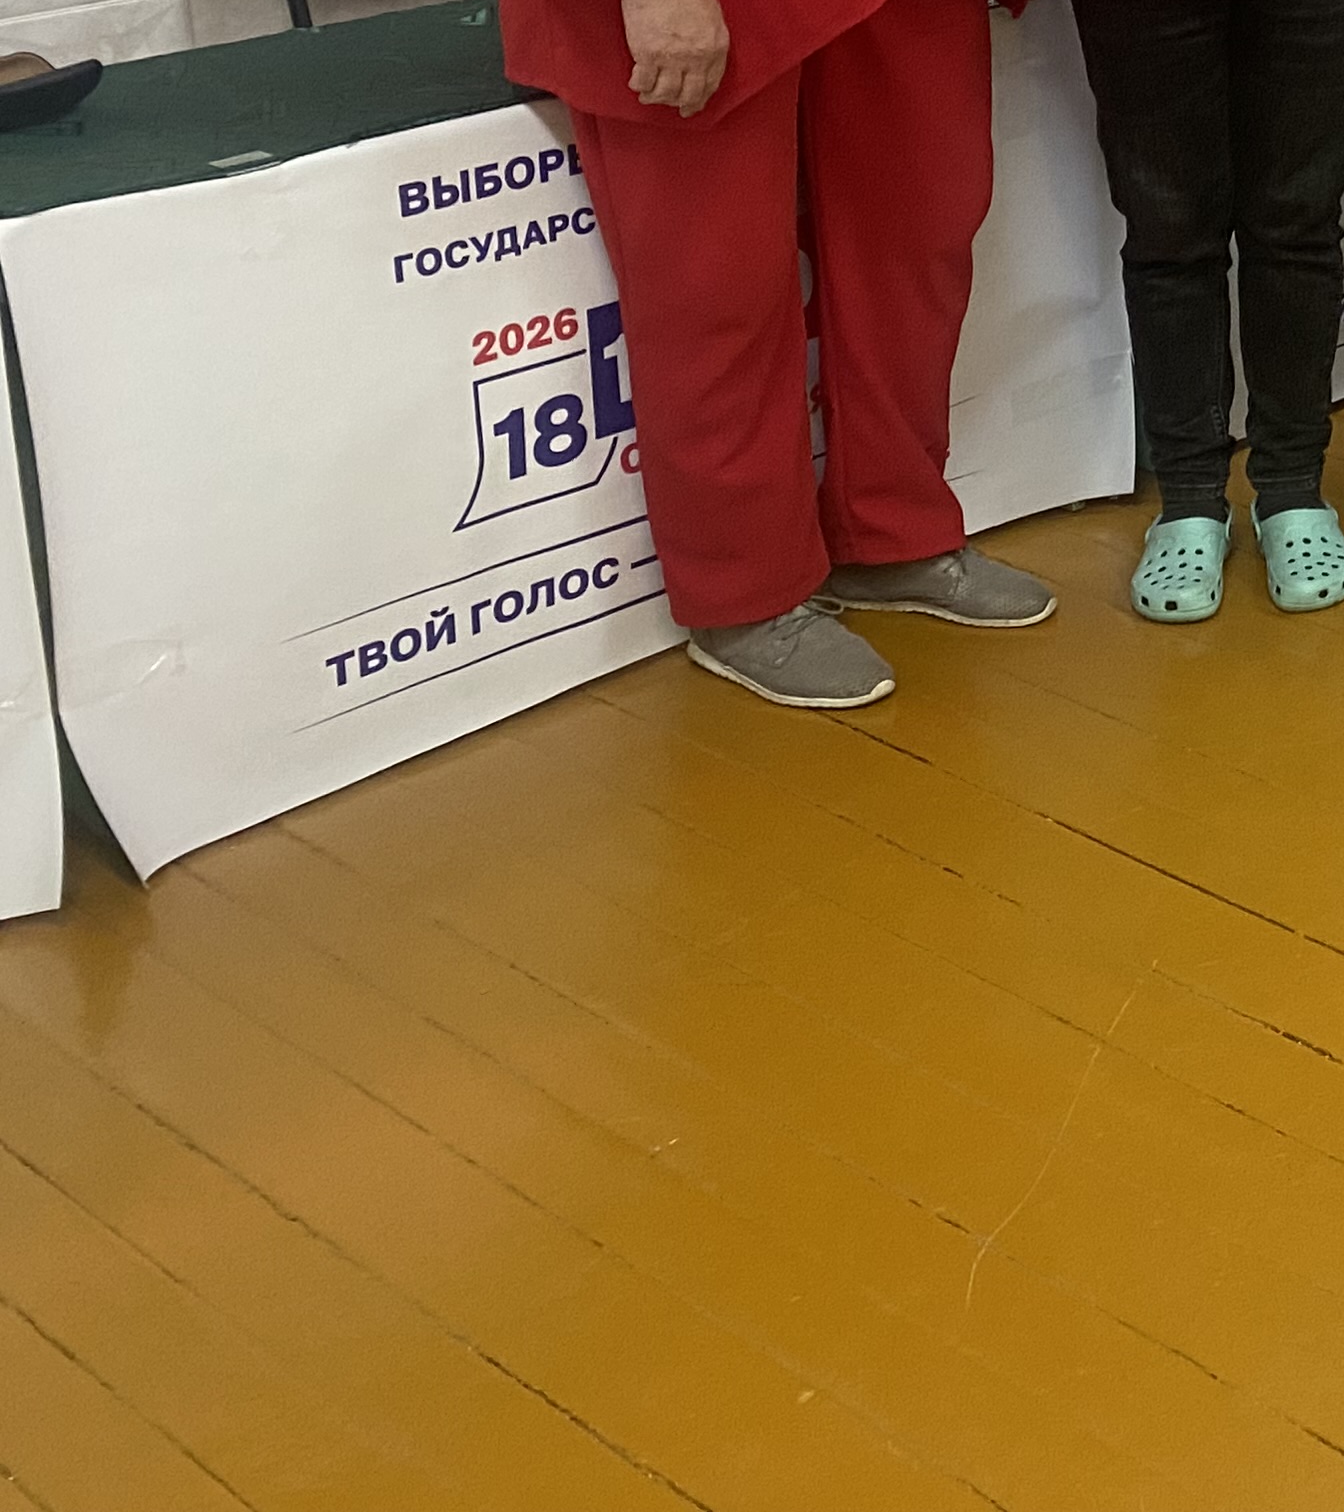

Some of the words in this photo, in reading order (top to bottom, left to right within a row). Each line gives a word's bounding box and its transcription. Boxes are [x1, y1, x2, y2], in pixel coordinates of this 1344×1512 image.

[393, 207, 596, 284] ГОСУДАРС
[472, 307, 580, 367] 2026
[603, 333, 632, 404] 1
[493, 393, 588, 481] 18
[325, 605, 457, 687] ТВОЙ
[471, 557, 620, 637] ГОЛОС
